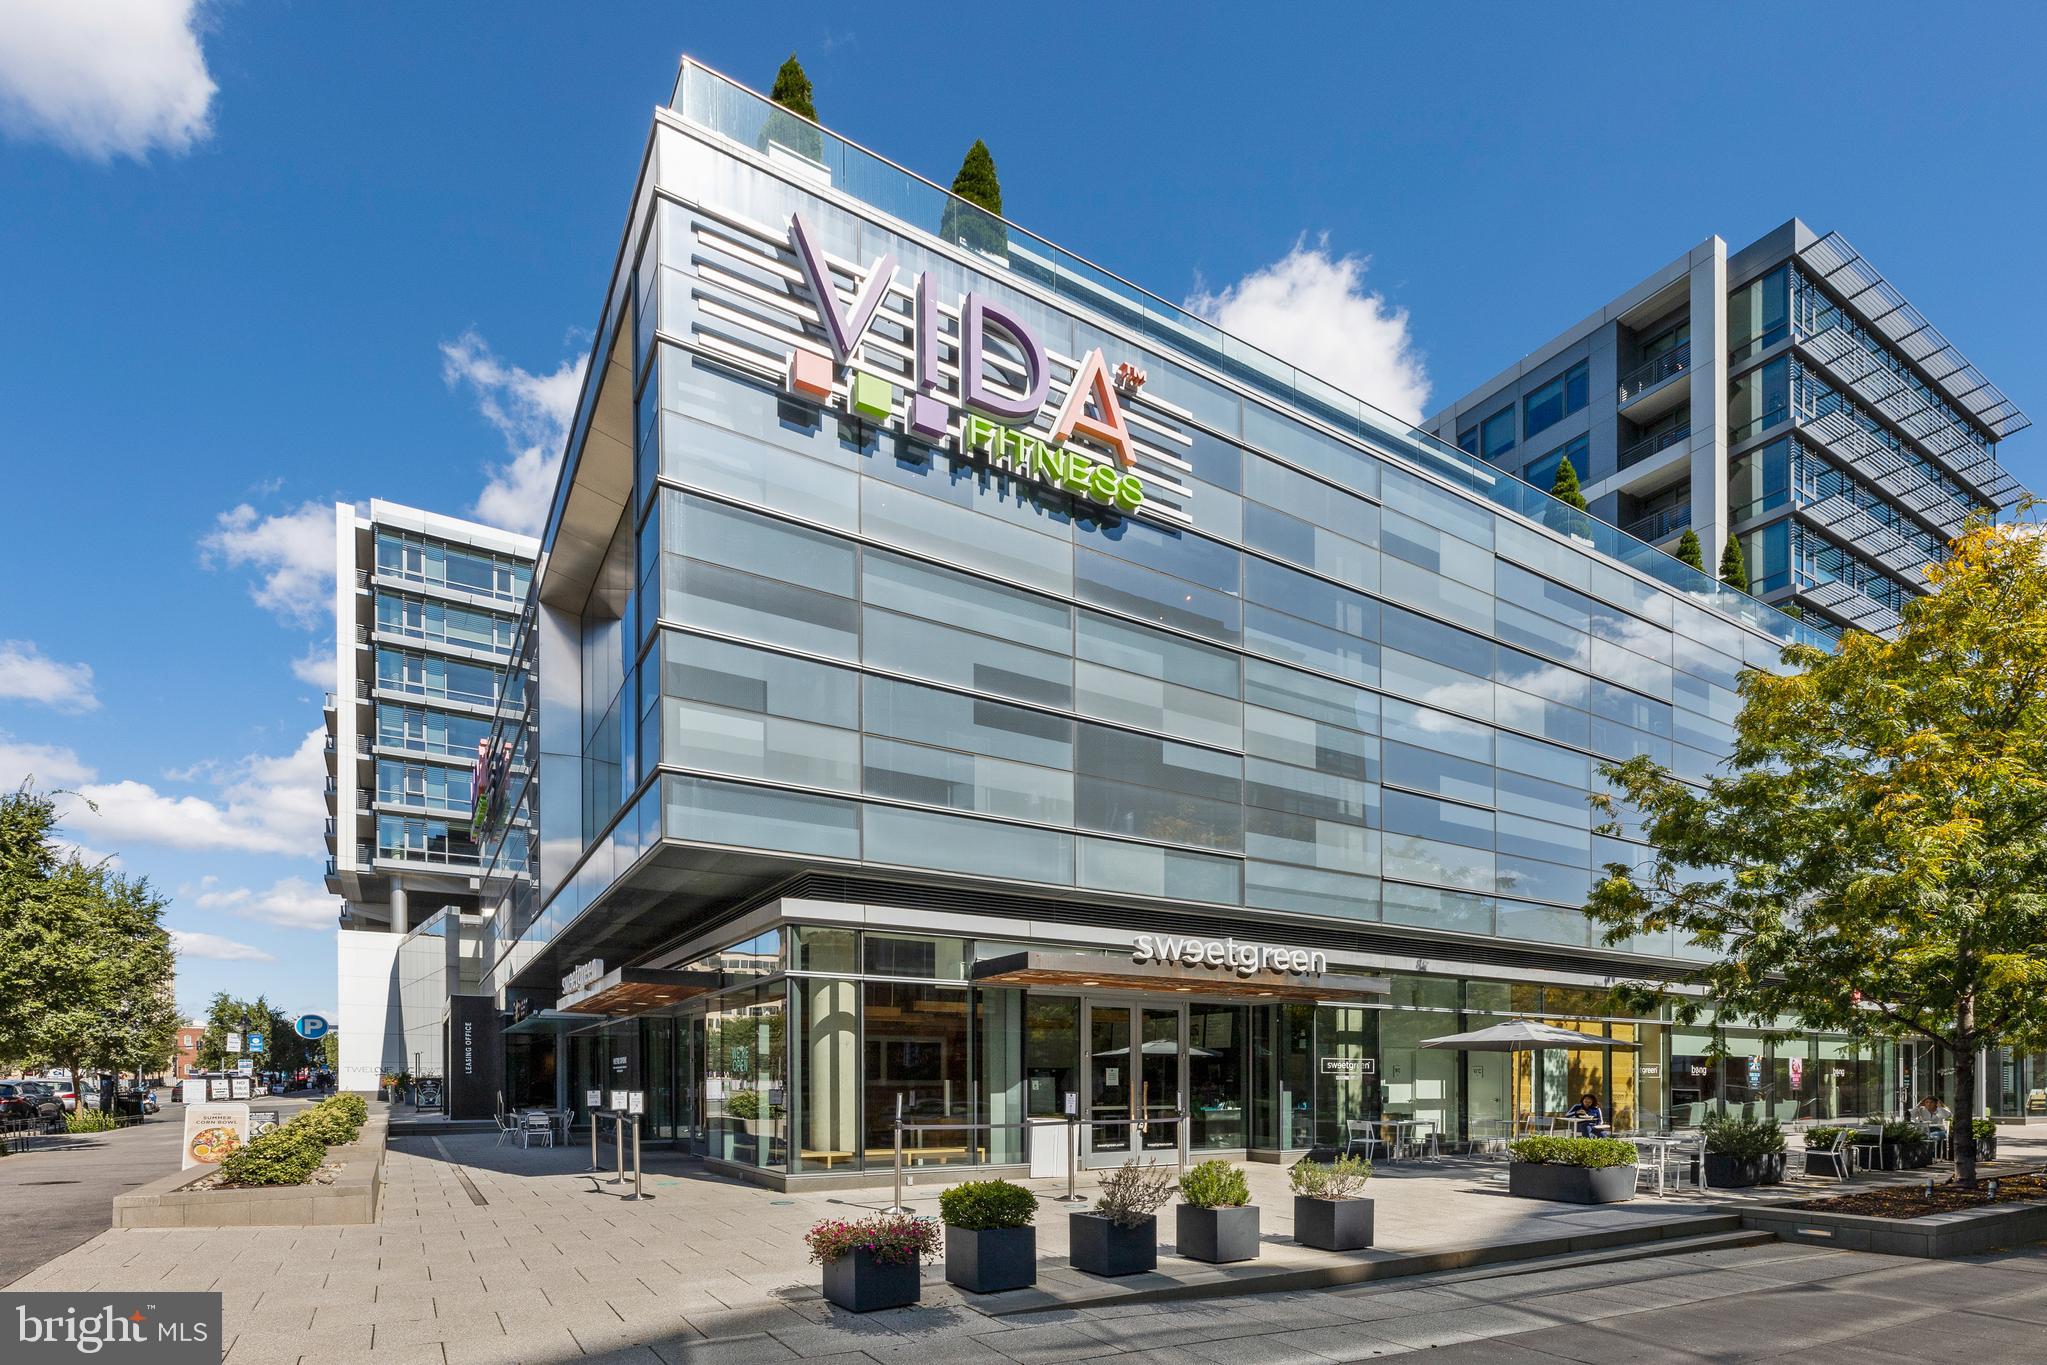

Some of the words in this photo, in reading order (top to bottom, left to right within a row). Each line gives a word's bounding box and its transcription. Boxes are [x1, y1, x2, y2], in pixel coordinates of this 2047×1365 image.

[964, 414, 1146, 513] FITNESS
[1133, 935, 1327, 973] sweetgreen
[464, 1022, 473, 1046] OFFICE
[464, 1047, 473, 1074] LEASING
